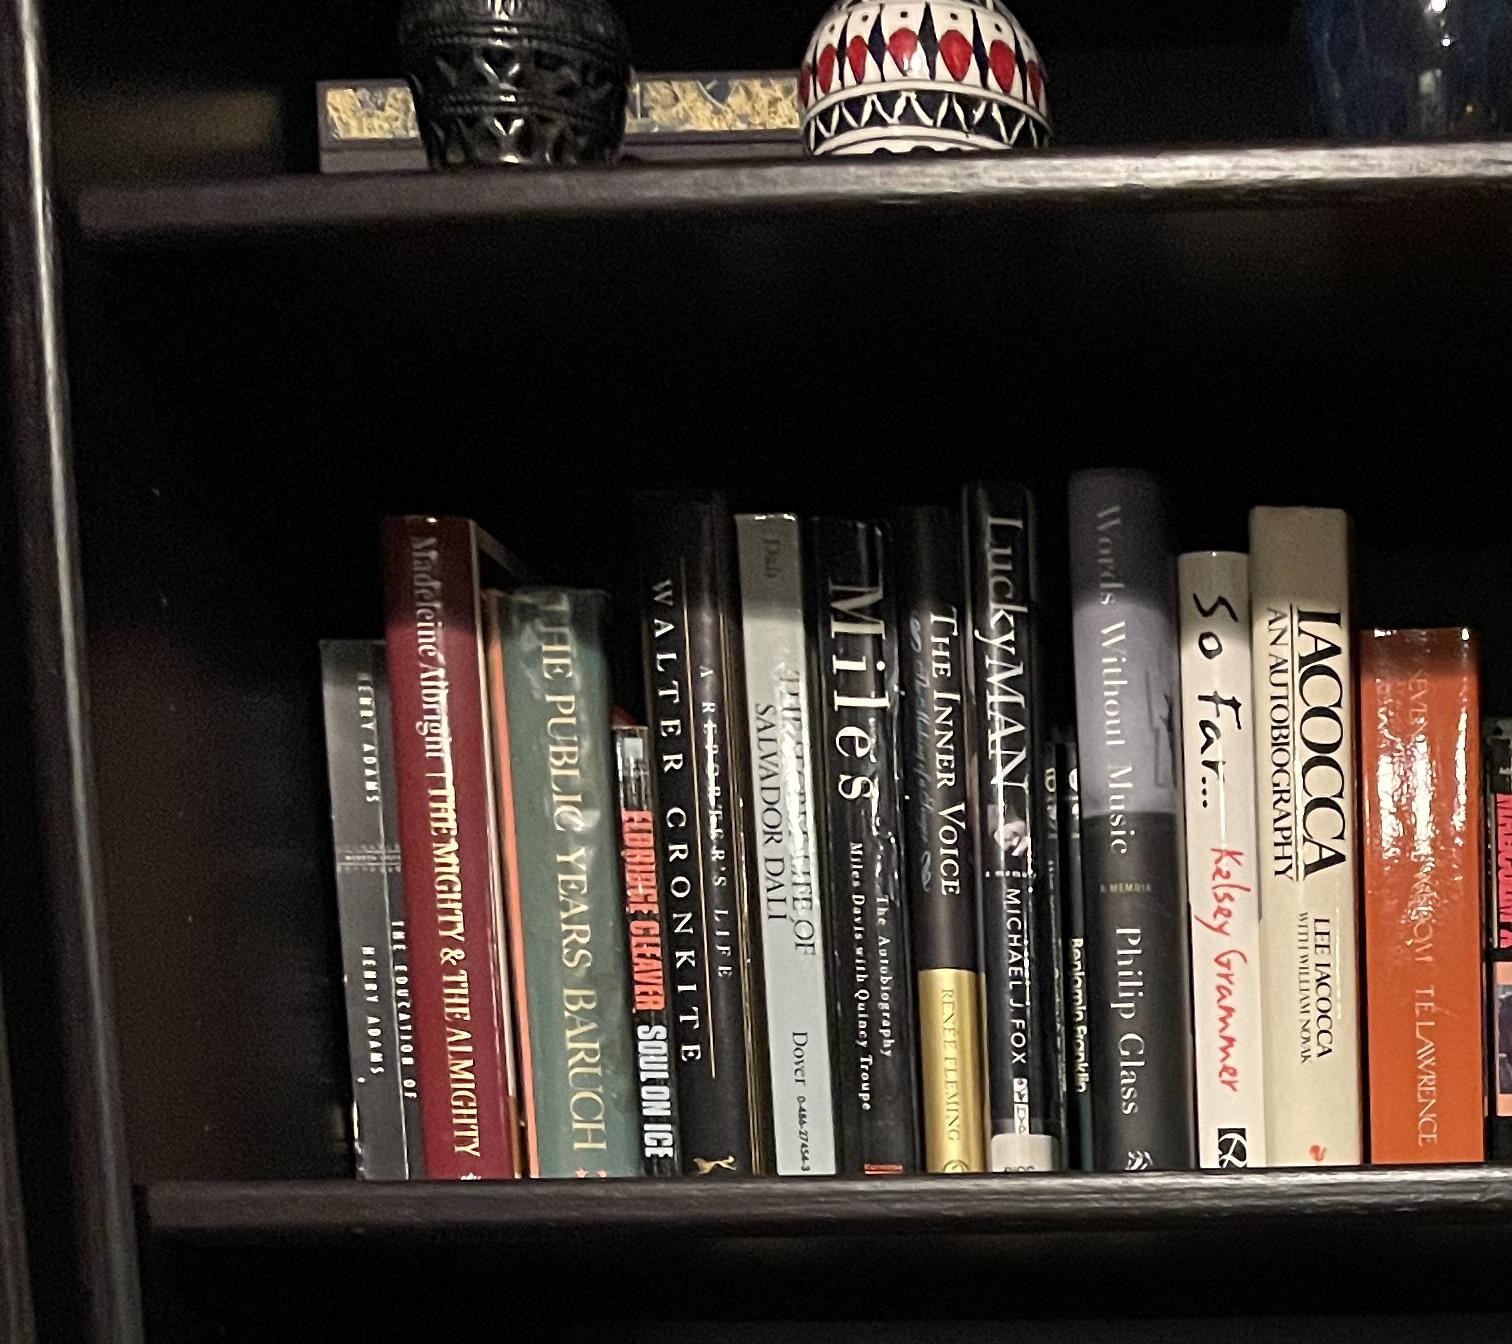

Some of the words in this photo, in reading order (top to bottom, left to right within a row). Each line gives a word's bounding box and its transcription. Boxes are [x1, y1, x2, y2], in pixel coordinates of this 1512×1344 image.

[1096, 505, 1126, 606] Words
[929, 607, 958, 678] THE
[1267, 608, 1289, 646] AN
[653, 579, 684, 772] WALTER
[830, 577, 890, 800] Miles
[1101, 621, 1129, 747] Without
[932, 690, 961, 789] INNER
[1269, 654, 1295, 882] AUTOBIOGRAPHY
[1297, 608, 1346, 880] IACOCCA
[938, 802, 966, 895] VOICE
[1109, 766, 1135, 854] Music
[667, 807, 701, 1062] CRONKITE
[875, 897, 890, 926] The
[1314, 917, 1331, 954] LEE
[878, 935, 895, 1058] Autobiography
[1111, 928, 1144, 1019] Philip
[1315, 962, 1333, 1058] IACOCCA
[637, 1025, 669, 1079] SOUL
[792, 1032, 808, 1086] Dover
[1119, 1033, 1145, 1116] Glass
[641, 1084, 671, 1116] ON
[644, 1123, 673, 1158] ICE
